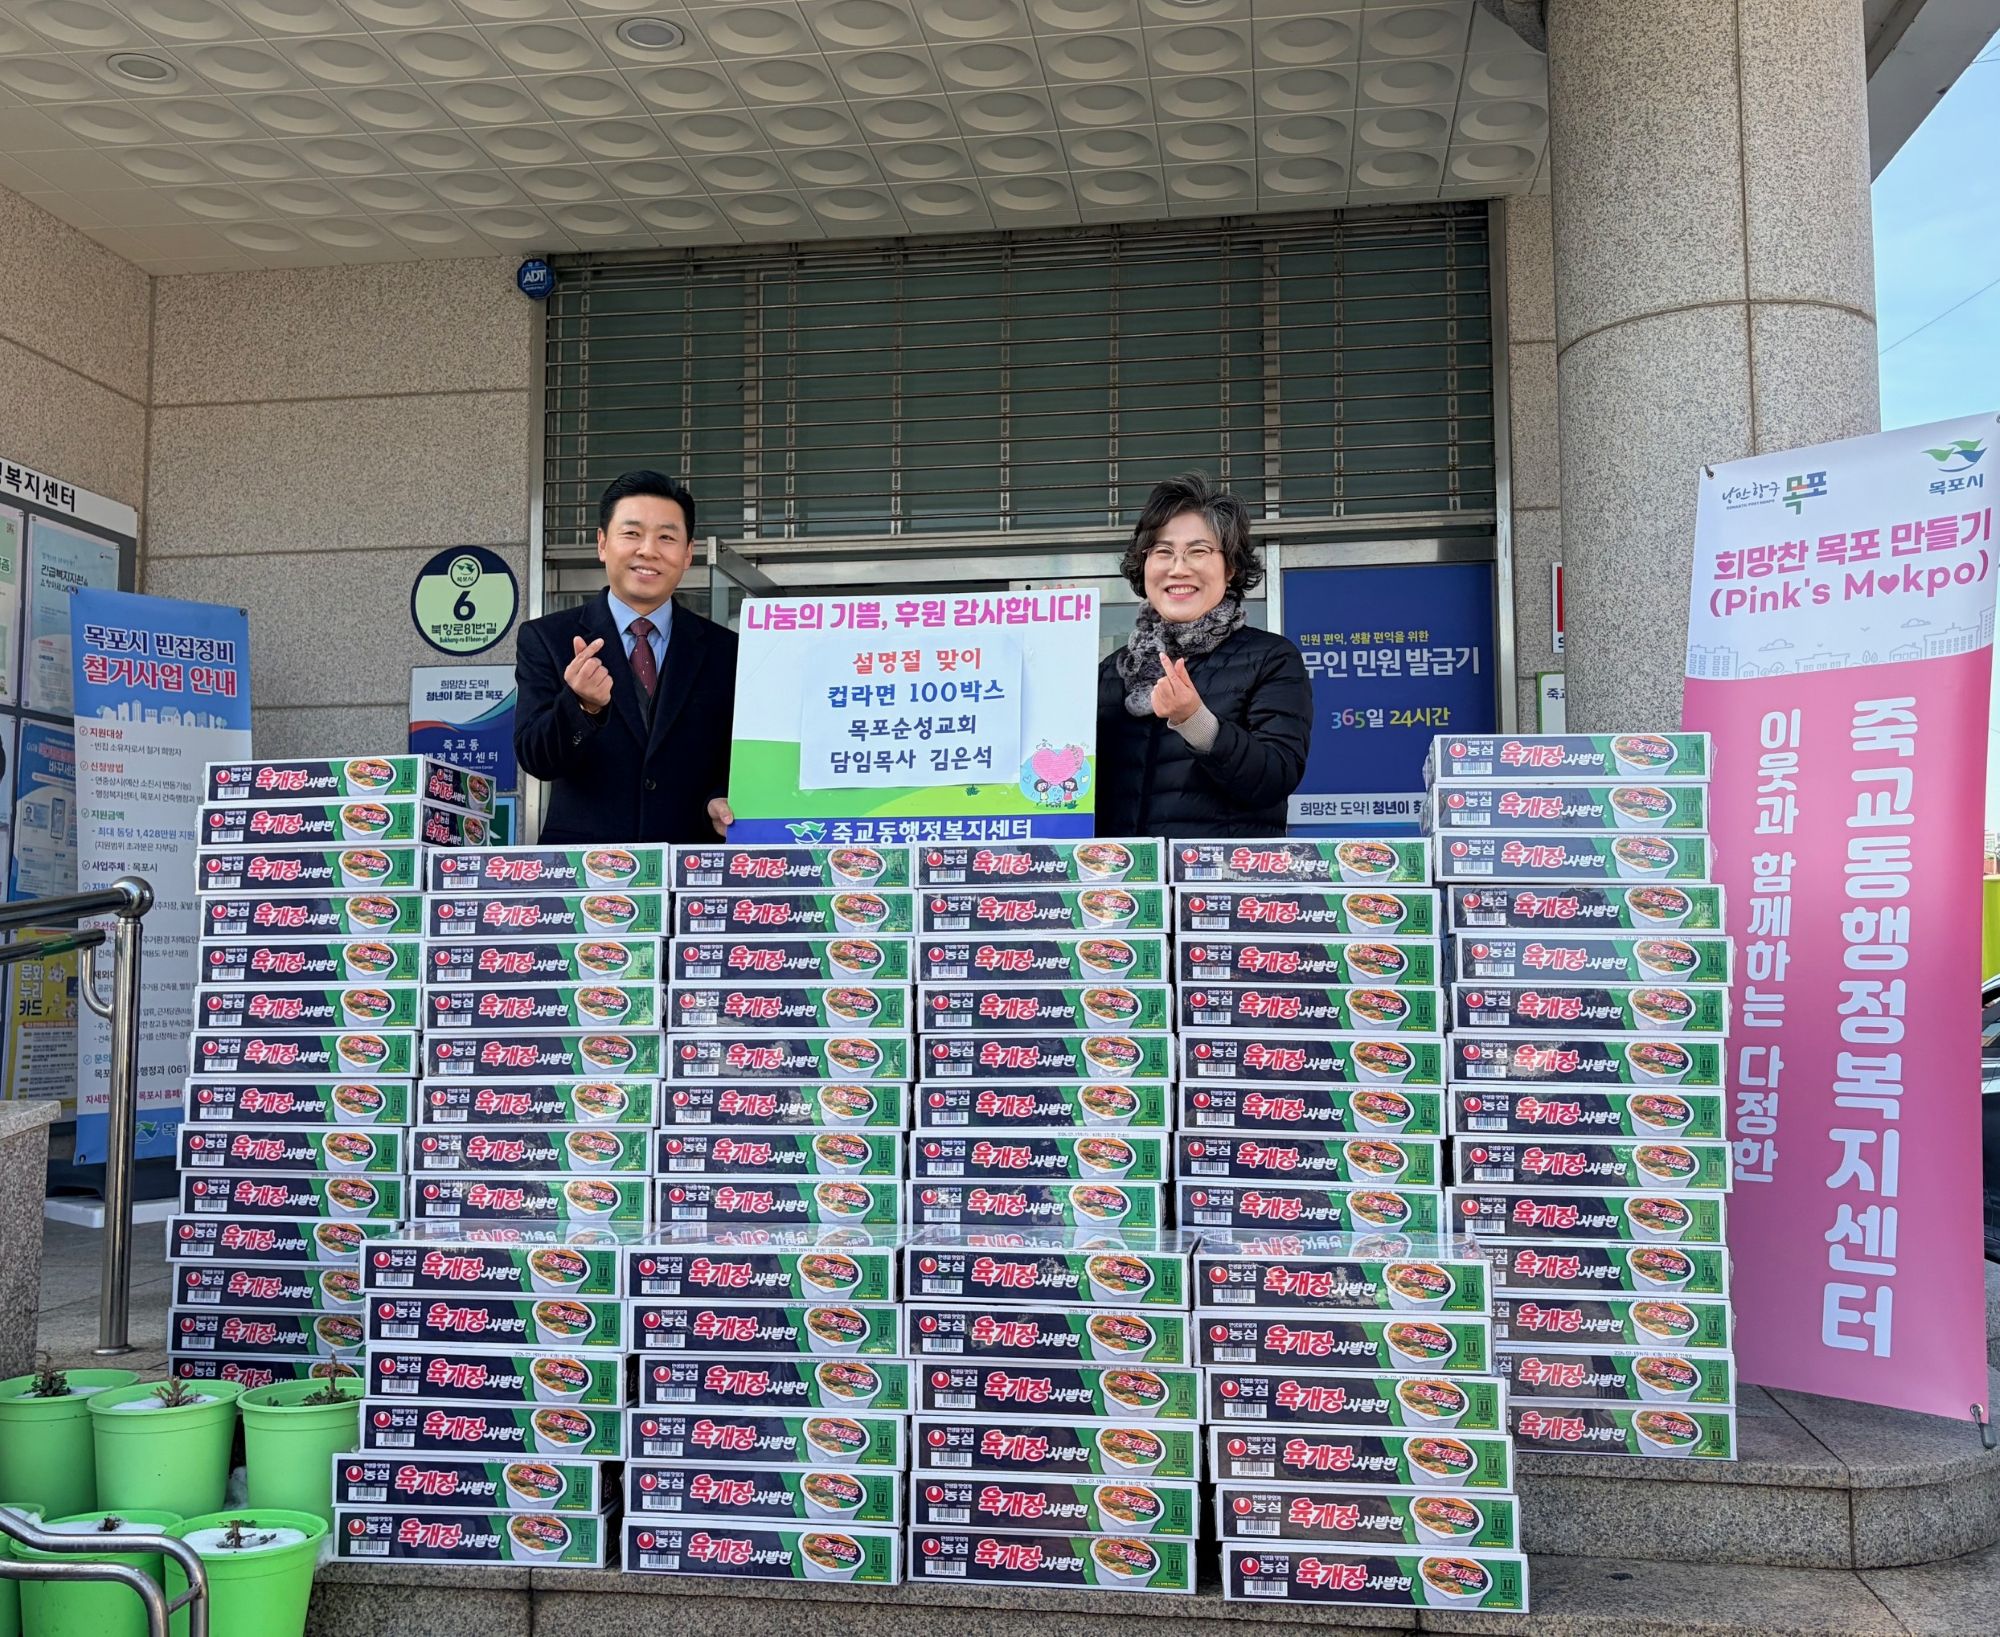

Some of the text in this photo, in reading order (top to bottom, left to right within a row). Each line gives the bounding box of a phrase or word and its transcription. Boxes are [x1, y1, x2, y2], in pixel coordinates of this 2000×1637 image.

[524, 270, 546, 282] ADT
[0, 462, 75, 512] 복지센터
[1782, 471, 1827, 515] 목포
[1929, 473, 1984, 495] 목포시
[1714, 507, 1992, 580] 희망찬 목포 만들기
[453, 591, 476, 621] 6
[1710, 578, 1830, 618] (Pink's
[748, 594, 1092, 630] 나눔의 기쁨, 후원 감사합니다!
[431, 623, 497, 636] 북항로81번길
[1300, 634, 1320, 646] 민원
[1350, 632, 1371, 645] 생활
[1373, 631, 1405, 644] 편익을
[1408, 630, 1429, 642] 위한
[85, 625, 235, 664] 목포시 빈집정비
[852, 647, 982, 675] 설명절 맞이
[1301, 646, 1480, 679] 무인 민원 발급기
[83, 654, 237, 697] 철거사업 안내
[441, 680, 489, 690] 희망찬 도약!
[426, 691, 452, 701] 청년이
[474, 691, 483, 700] 큰
[486, 691, 503, 700] 목포
[827, 679, 1005, 707] 컵라면 100박스
[848, 714, 977, 742] 목포순성교회
[1331, 707, 1451, 729] 365일 24시간
[90, 727, 123, 740] 지원대상
[830, 746, 992, 774] 담임목사 김은석
[1467, 744, 1494, 756] 농심
[1500, 741, 1605, 767] 육개장 사발면
[230, 771, 252, 781] 농심
[256, 769, 337, 789] 육개장 사발면
[224, 814, 246, 823] 농심
[1300, 801, 1337, 816] 희망찬
[1340, 801, 1370, 815] 도약!
[1373, 800, 1410, 815] 청년이
[251, 811, 336, 833] 육개장 사발면
[831, 819, 1032, 845] 죽교동행정복지센터
[92, 860, 126, 872] 사업주체
[1731, 708, 1801, 1184] 이웃과 함께하는 다정한
[18, 1000, 43, 1017] 카드
[450, 997, 474, 1006] 농심
[480, 994, 567, 1018] 육개장 사발면
[696, 996, 719, 1006] 농심
[725, 993, 817, 1018] 육개장 사발면
[1822, 696, 1919, 1359] 죽교동행정복지센터
[949, 1046, 974, 1055] 농심
[981, 1043, 1075, 1068] 육개장 사발면
[212, 1092, 235, 1101] 농심
[240, 1089, 328, 1111] 육개장 사발면
[1211, 1096, 1237, 1106] 농심
[1243, 1093, 1342, 1121] 육개장 사발면
[1490, 1150, 1516, 1161] 농심
[1523, 1147, 1625, 1176] 육개장 사발면
[391, 1254, 416, 1265] 농심
[423, 1252, 521, 1280] 육개장 사발면
[657, 1261, 684, 1272] 농심
[937, 1260, 965, 1272] 농심
[690, 1258, 789, 1288] 육개장 사발면
[972, 1257, 1079, 1288] 육개장 사발면
[1229, 1328, 1258, 1340] 농심
[1265, 1325, 1377, 1356] 육개장 사발면
[391, 1414, 418, 1426] 농심
[425, 1412, 524, 1441] 육개장 사발면
[656, 1536, 683, 1548] 농심
[689, 1533, 790, 1564] 육개장 사발면
[940, 1542, 968, 1554] 농심
[975, 1539, 1083, 1571] 육개장 사발면
[1259, 1561, 1289, 1574] 농심
[1297, 1558, 1412, 1591] 육개장 사발면
